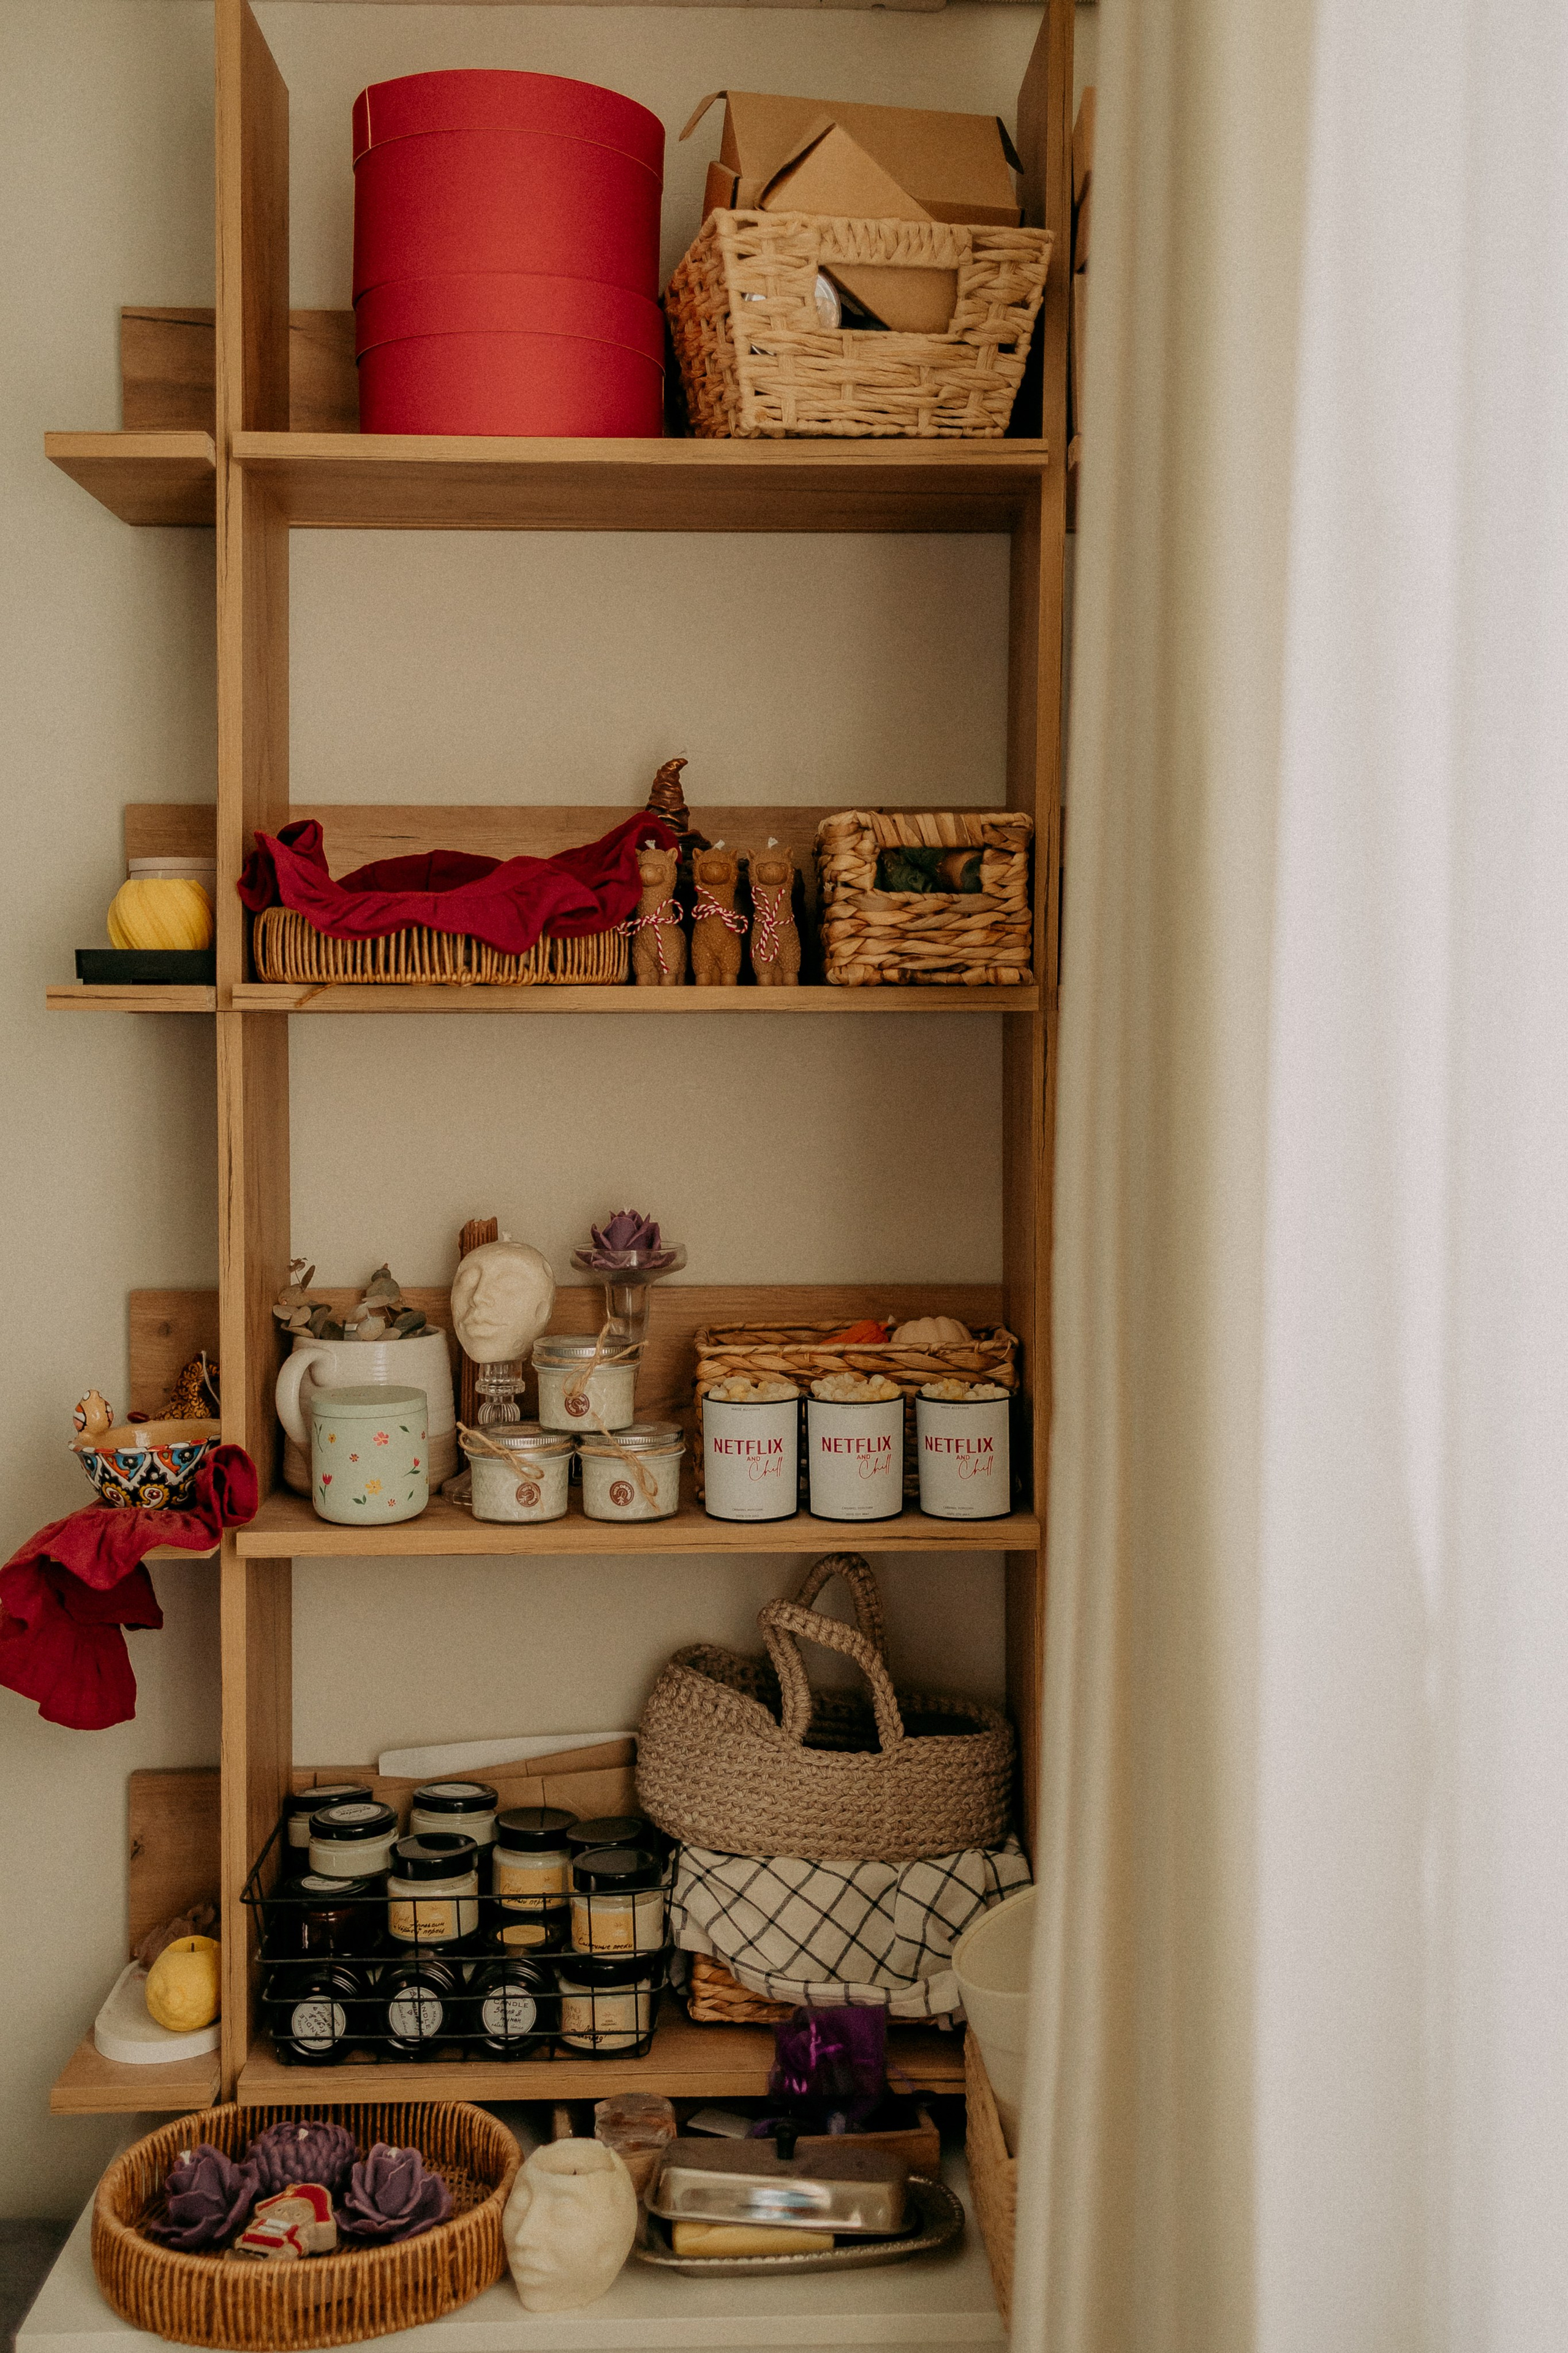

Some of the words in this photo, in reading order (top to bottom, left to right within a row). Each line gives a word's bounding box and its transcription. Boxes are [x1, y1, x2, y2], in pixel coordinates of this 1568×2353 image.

[714, 1438, 783, 1455] NETFLIX
[821, 1435, 892, 1453] NETFLIX
[925, 1435, 993, 1453] NETFLIX
[748, 1456, 783, 1481] Chill
[859, 1454, 892, 1479] Chill
[959, 1456, 993, 1480] Chill
[619, 1484, 631, 1500] ORGANIC
[423, 1928, 445, 1936] перец
